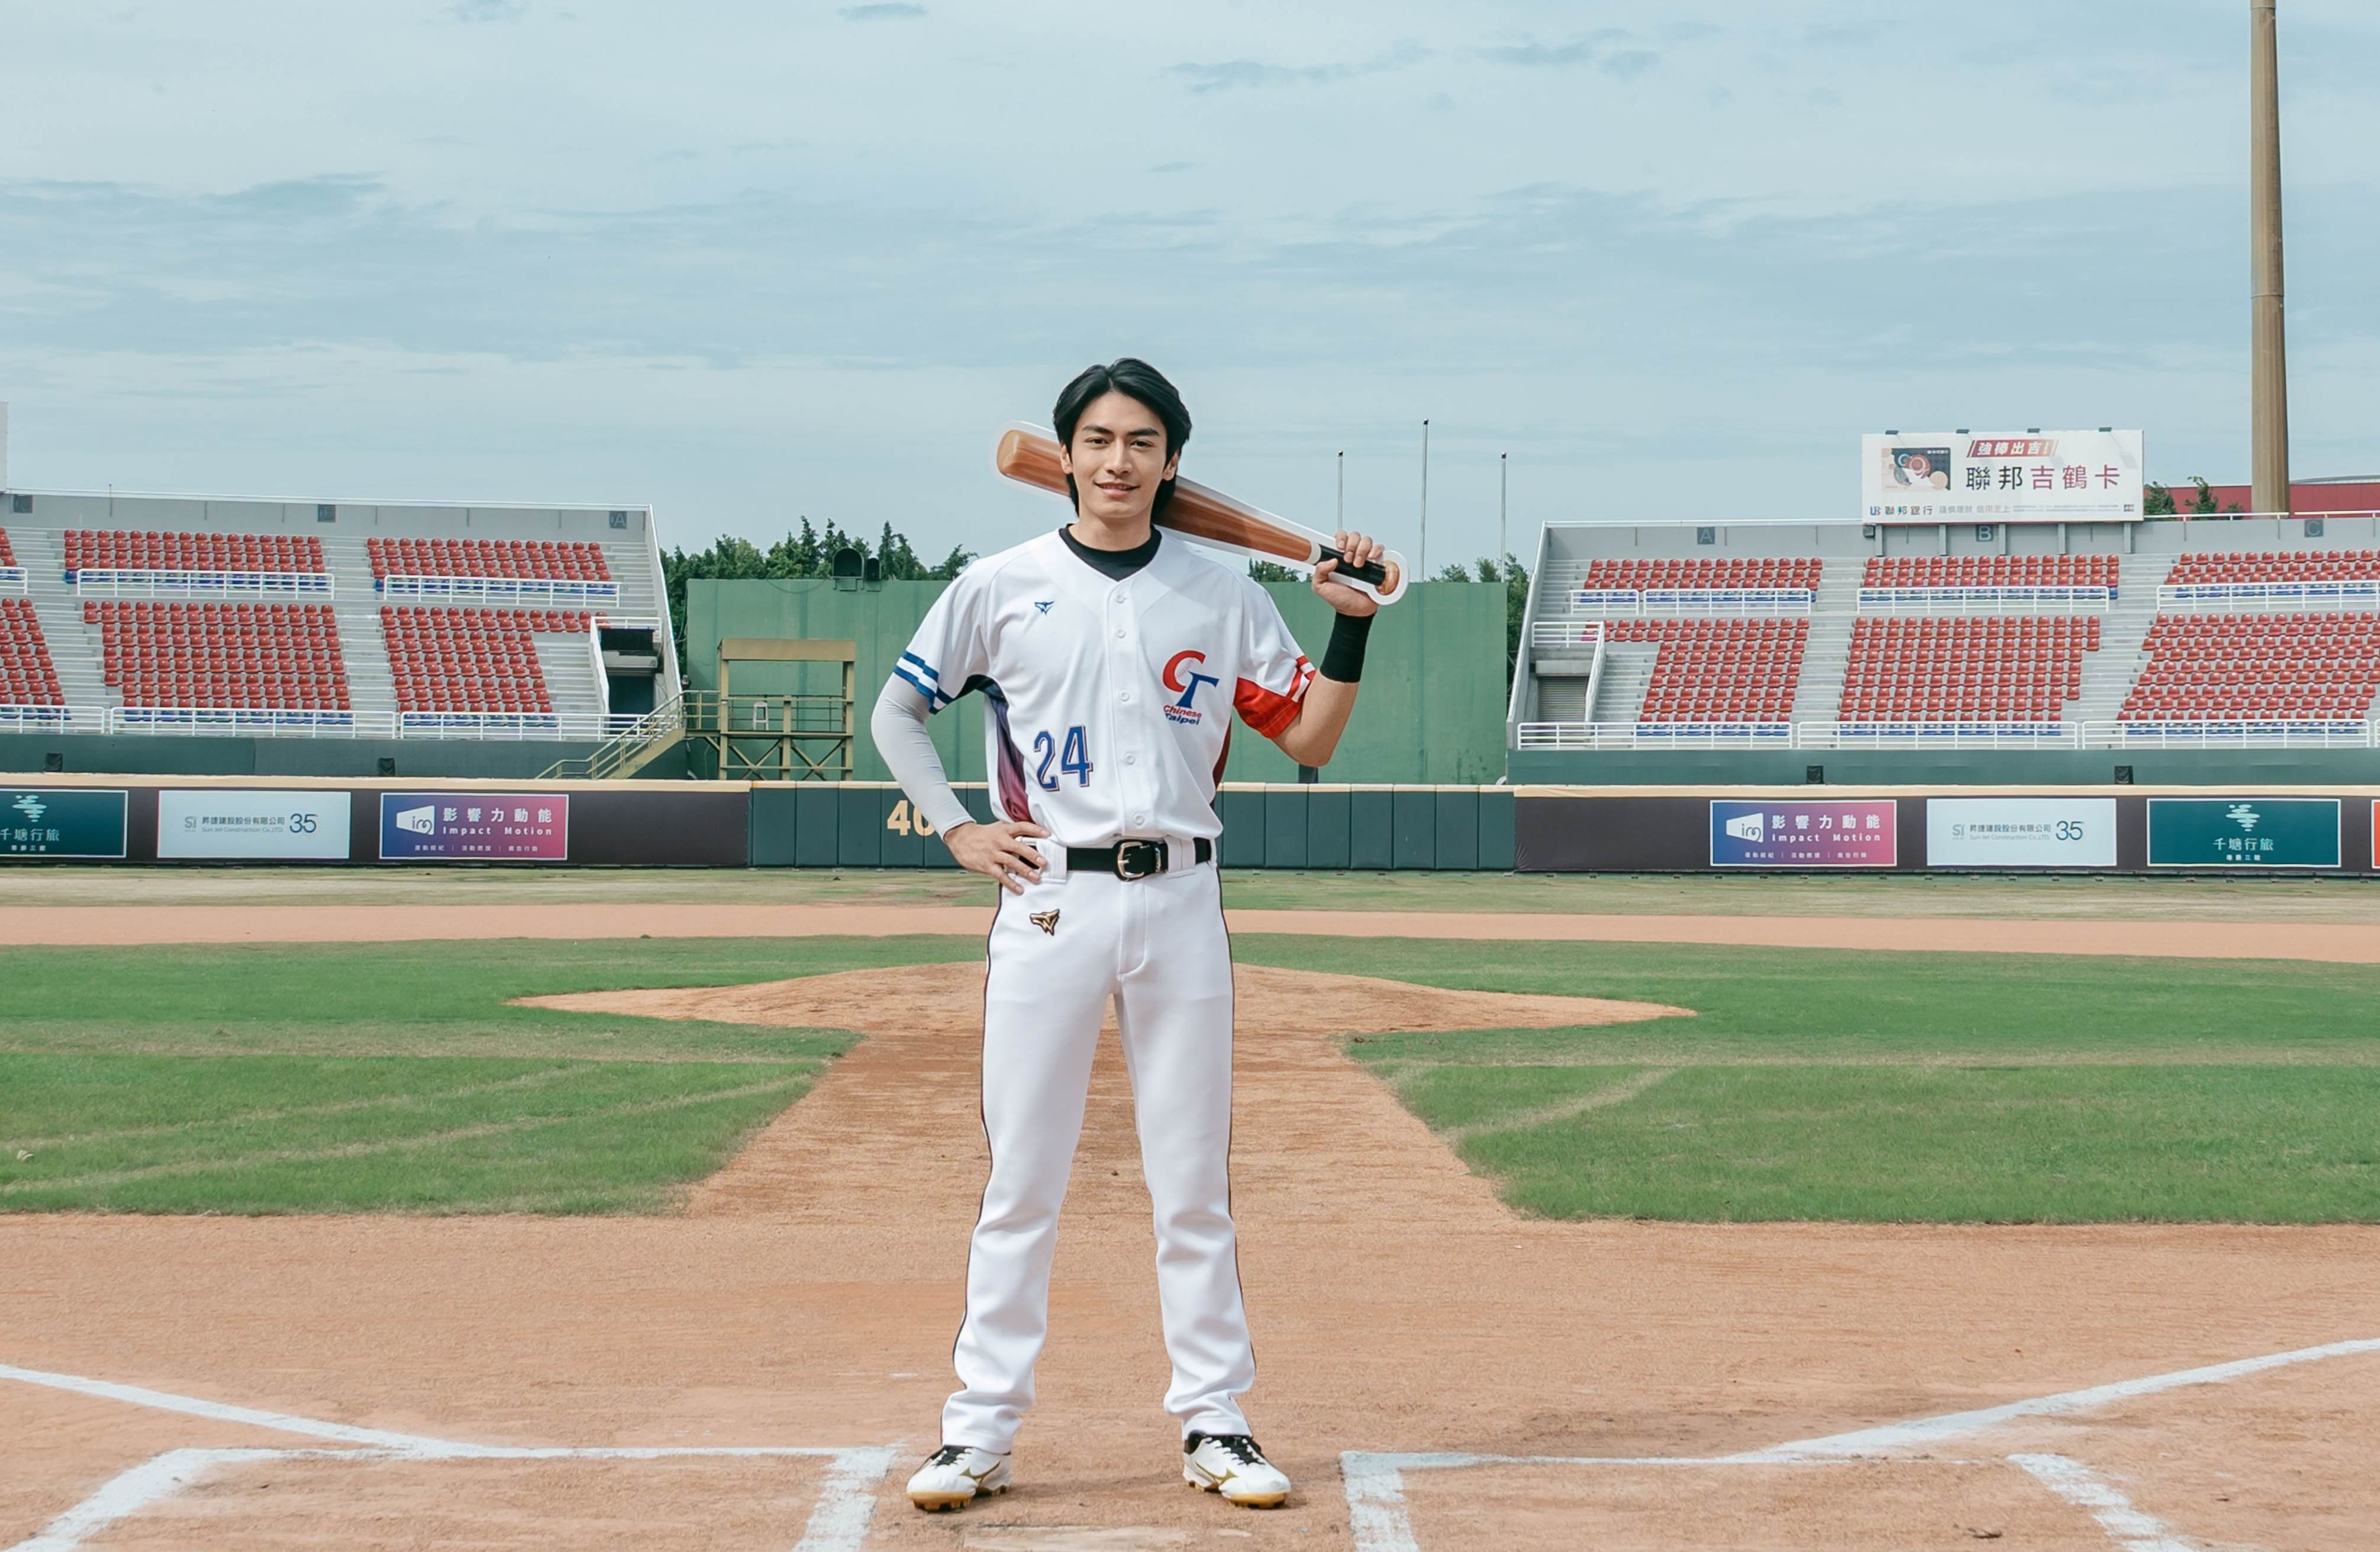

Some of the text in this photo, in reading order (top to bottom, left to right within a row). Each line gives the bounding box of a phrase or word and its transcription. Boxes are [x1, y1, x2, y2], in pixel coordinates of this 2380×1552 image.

[1965, 464, 2120, 490] 聯邦吉鶴卡
[1699, 528, 1713, 543] A
[1978, 525, 1992, 541] B
[2306, 520, 2320, 536] C
[1163, 705, 1202, 719] Chinese
[1165, 712, 1200, 725] Taipei
[1033, 724, 1094, 792] 24
[289, 813, 318, 833] 35
[443, 807, 552, 823] 影響力動能
[1772, 814, 1881, 829] 影響力動能
[443, 827, 552, 835] Impact Motion
[1772, 833, 1881, 843] Impact Motion
[2056, 820, 2084, 840] 35
